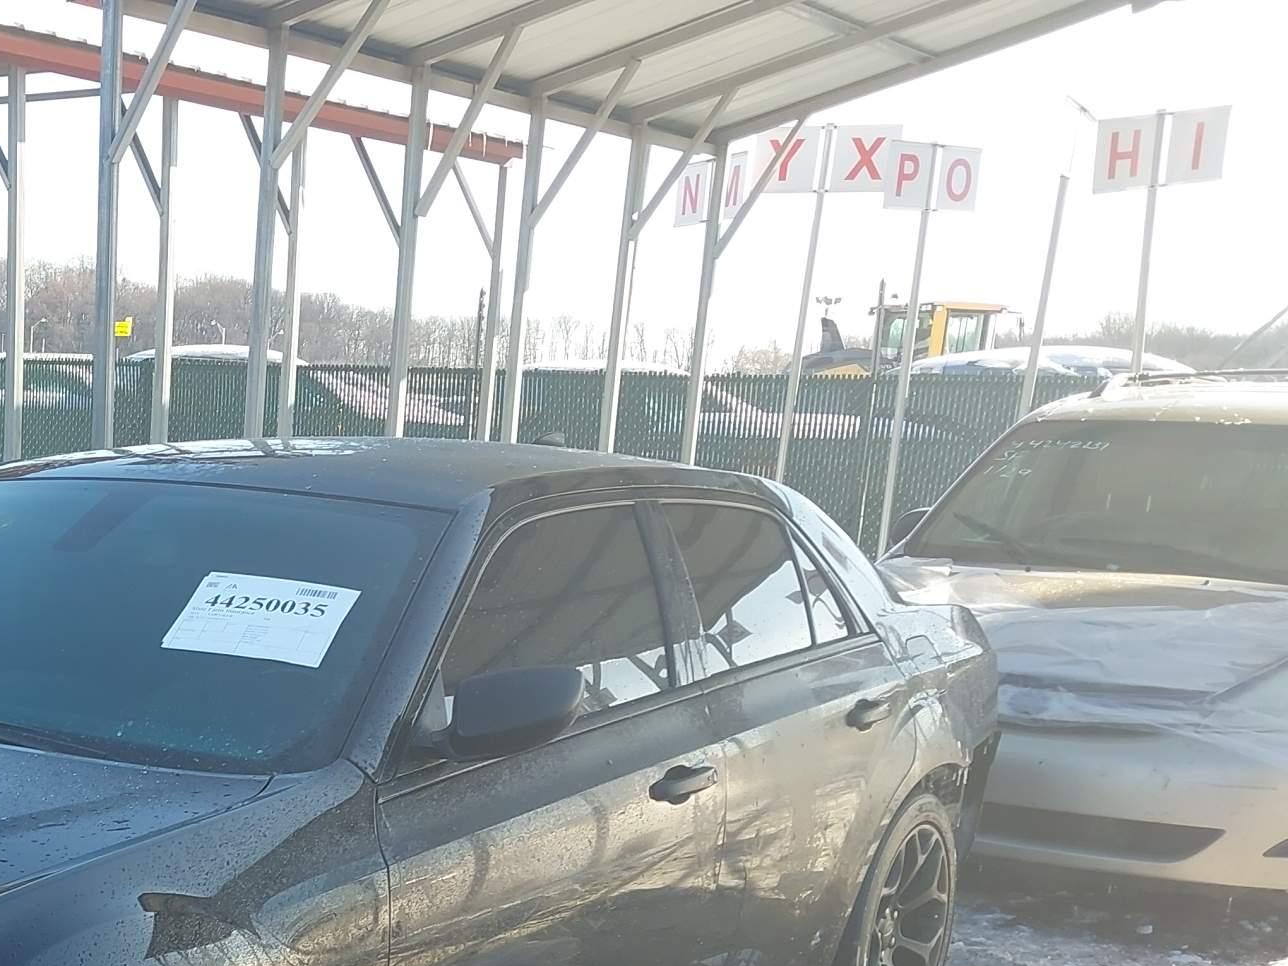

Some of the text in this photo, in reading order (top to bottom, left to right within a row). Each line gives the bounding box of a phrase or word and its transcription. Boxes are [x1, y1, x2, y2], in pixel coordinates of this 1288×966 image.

[769, 136, 886, 181] Y X
[895, 152, 972, 202] P O
[1107, 129, 1141, 180] H
[681, 173, 700, 216] N
[204, 594, 329, 618] 44250035
